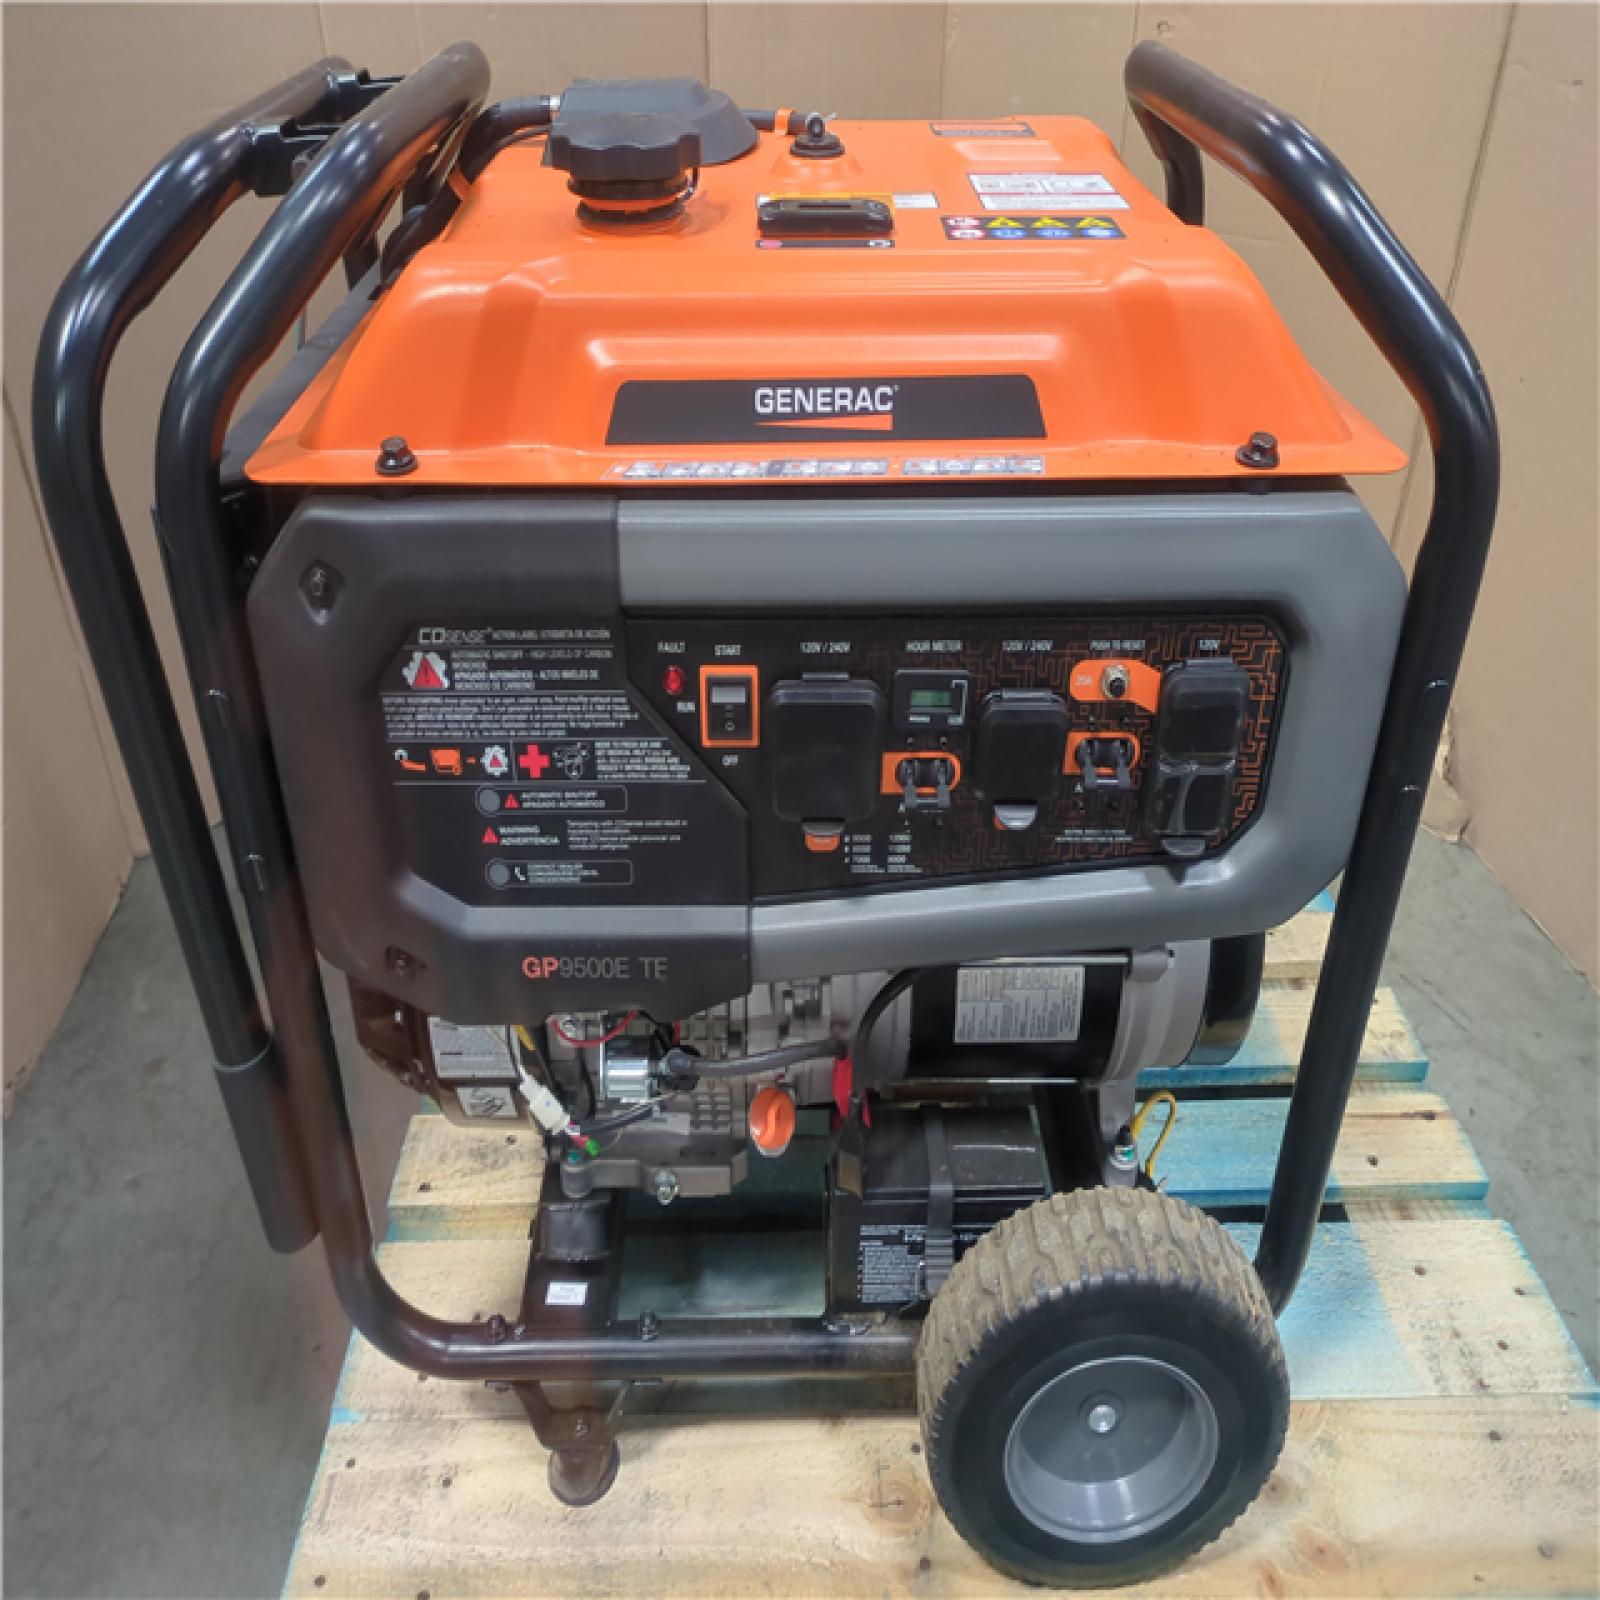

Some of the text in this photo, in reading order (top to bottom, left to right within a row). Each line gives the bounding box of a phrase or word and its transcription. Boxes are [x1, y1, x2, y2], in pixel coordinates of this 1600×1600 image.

[754, 386, 894, 413] GENERAC
[657, 641, 686, 653] FAULT
[714, 644, 742, 656] START
[905, 640, 963, 652] HOUR METER
[676, 701, 696, 713] RUN
[722, 754, 739, 767] OFF
[522, 956, 630, 978] GP9500E
